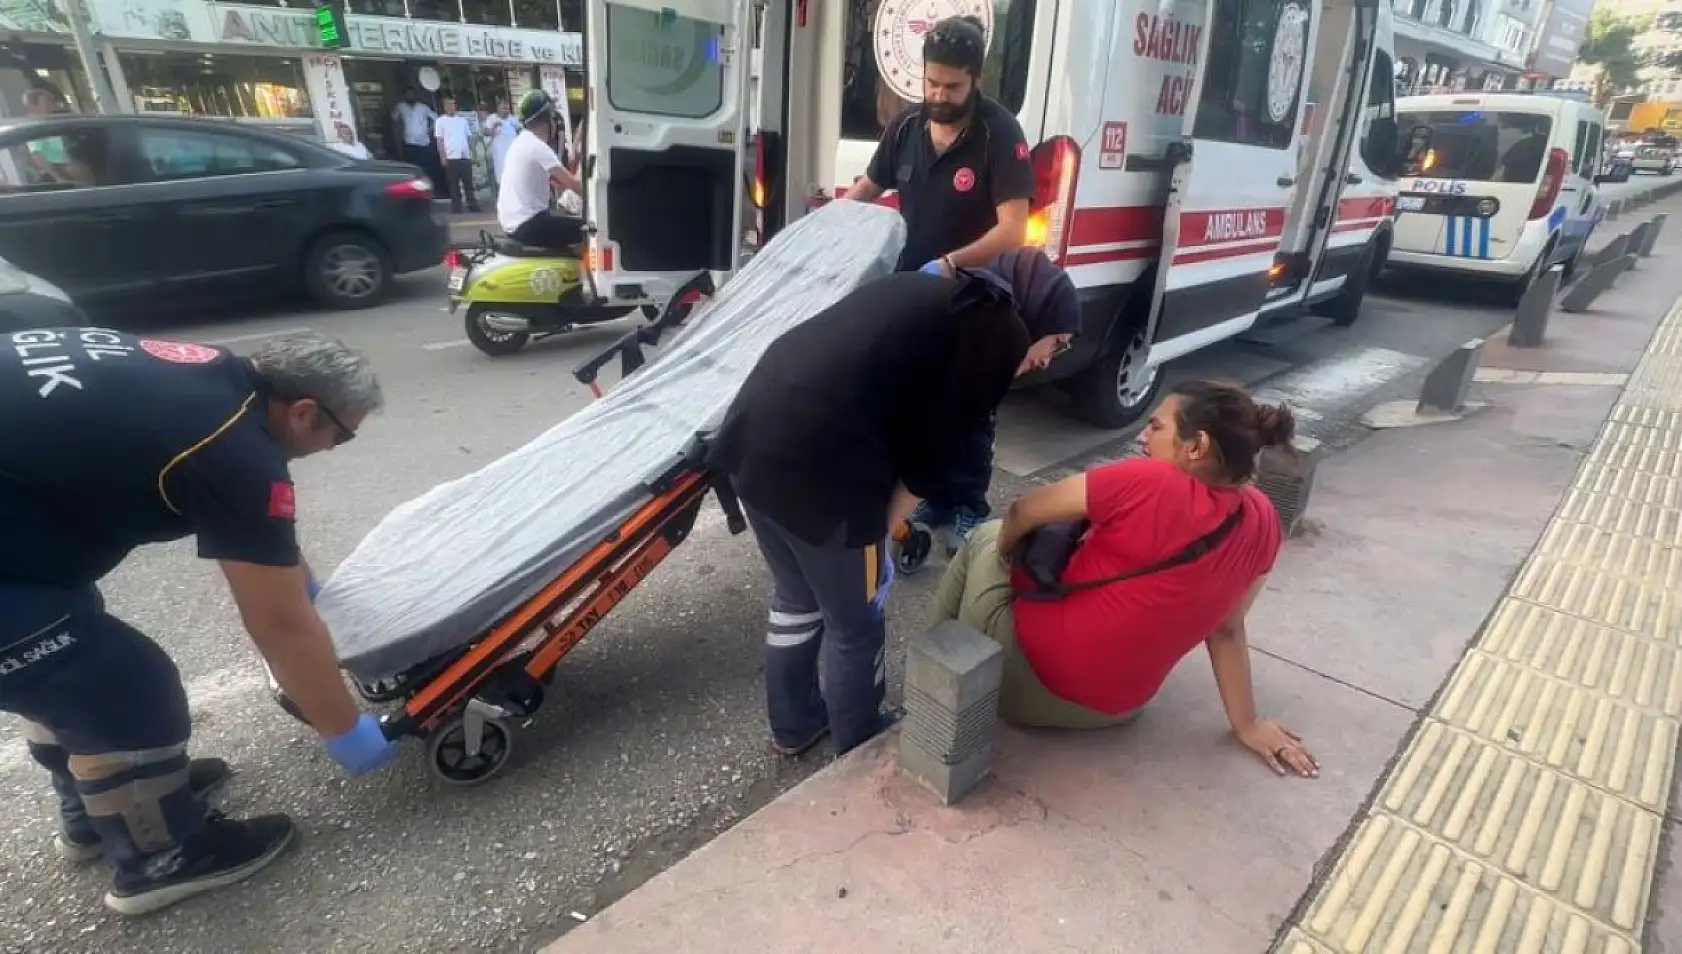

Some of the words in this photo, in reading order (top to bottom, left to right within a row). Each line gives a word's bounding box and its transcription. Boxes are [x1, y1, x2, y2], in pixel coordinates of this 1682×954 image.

[1134, 11, 1202, 64] SAĞLIK
[1105, 126, 1124, 151] 112
[1411, 179, 1468, 194] POLİS
[1204, 210, 1267, 241] AMBULANS
